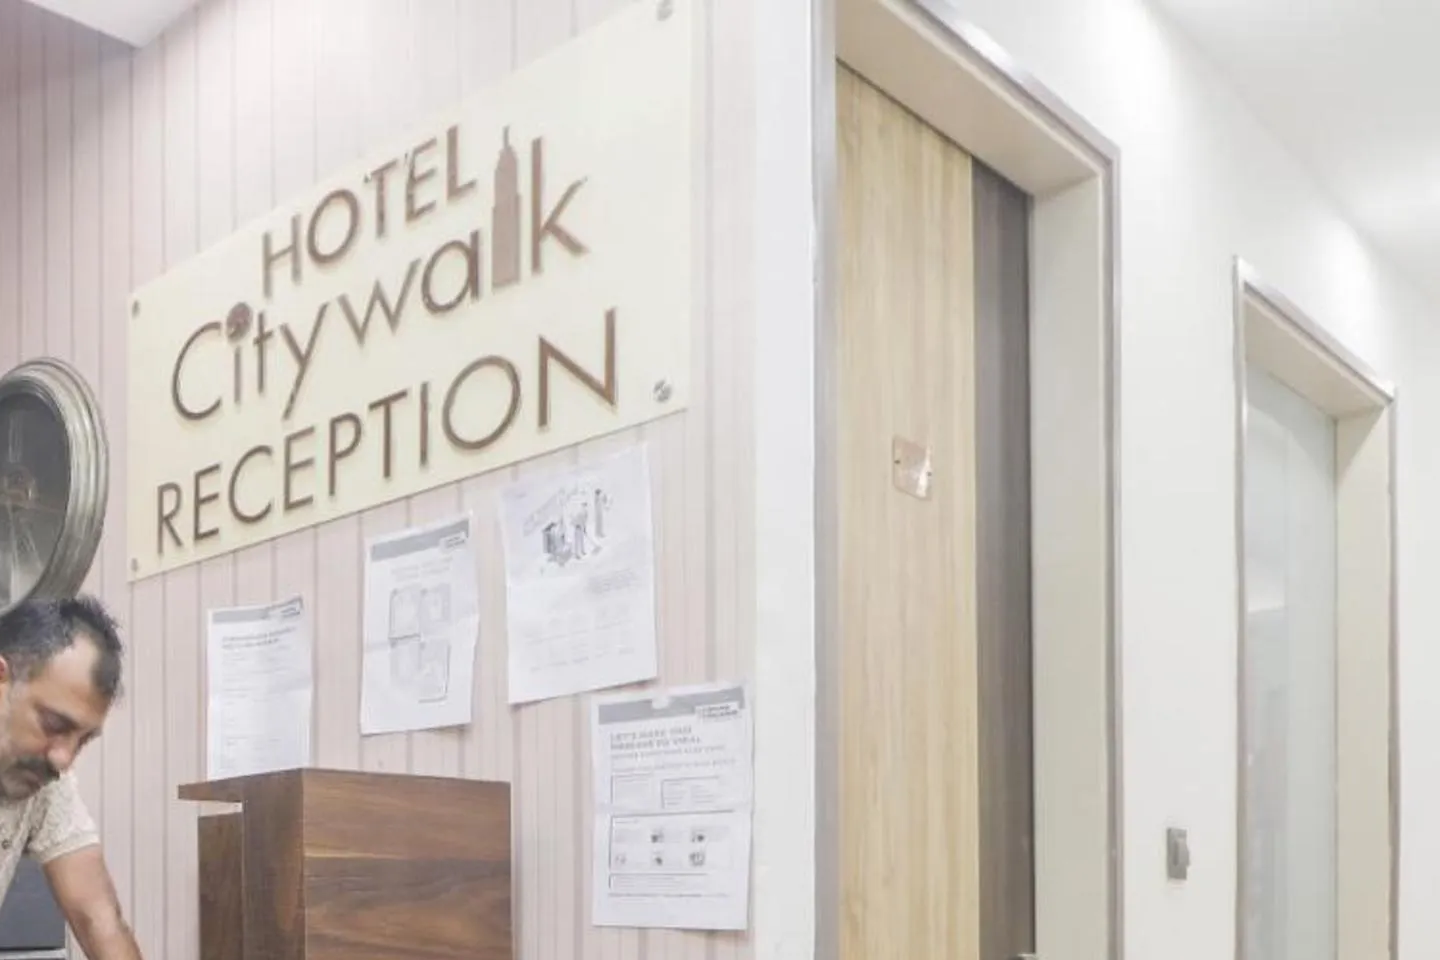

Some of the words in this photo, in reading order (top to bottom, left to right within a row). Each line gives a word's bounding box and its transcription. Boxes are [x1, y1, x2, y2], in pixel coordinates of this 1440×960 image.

[171, 125, 587, 421] Citywalk
[262, 124, 477, 298] HOTEL
[158, 307, 616, 555] RECEPTION
